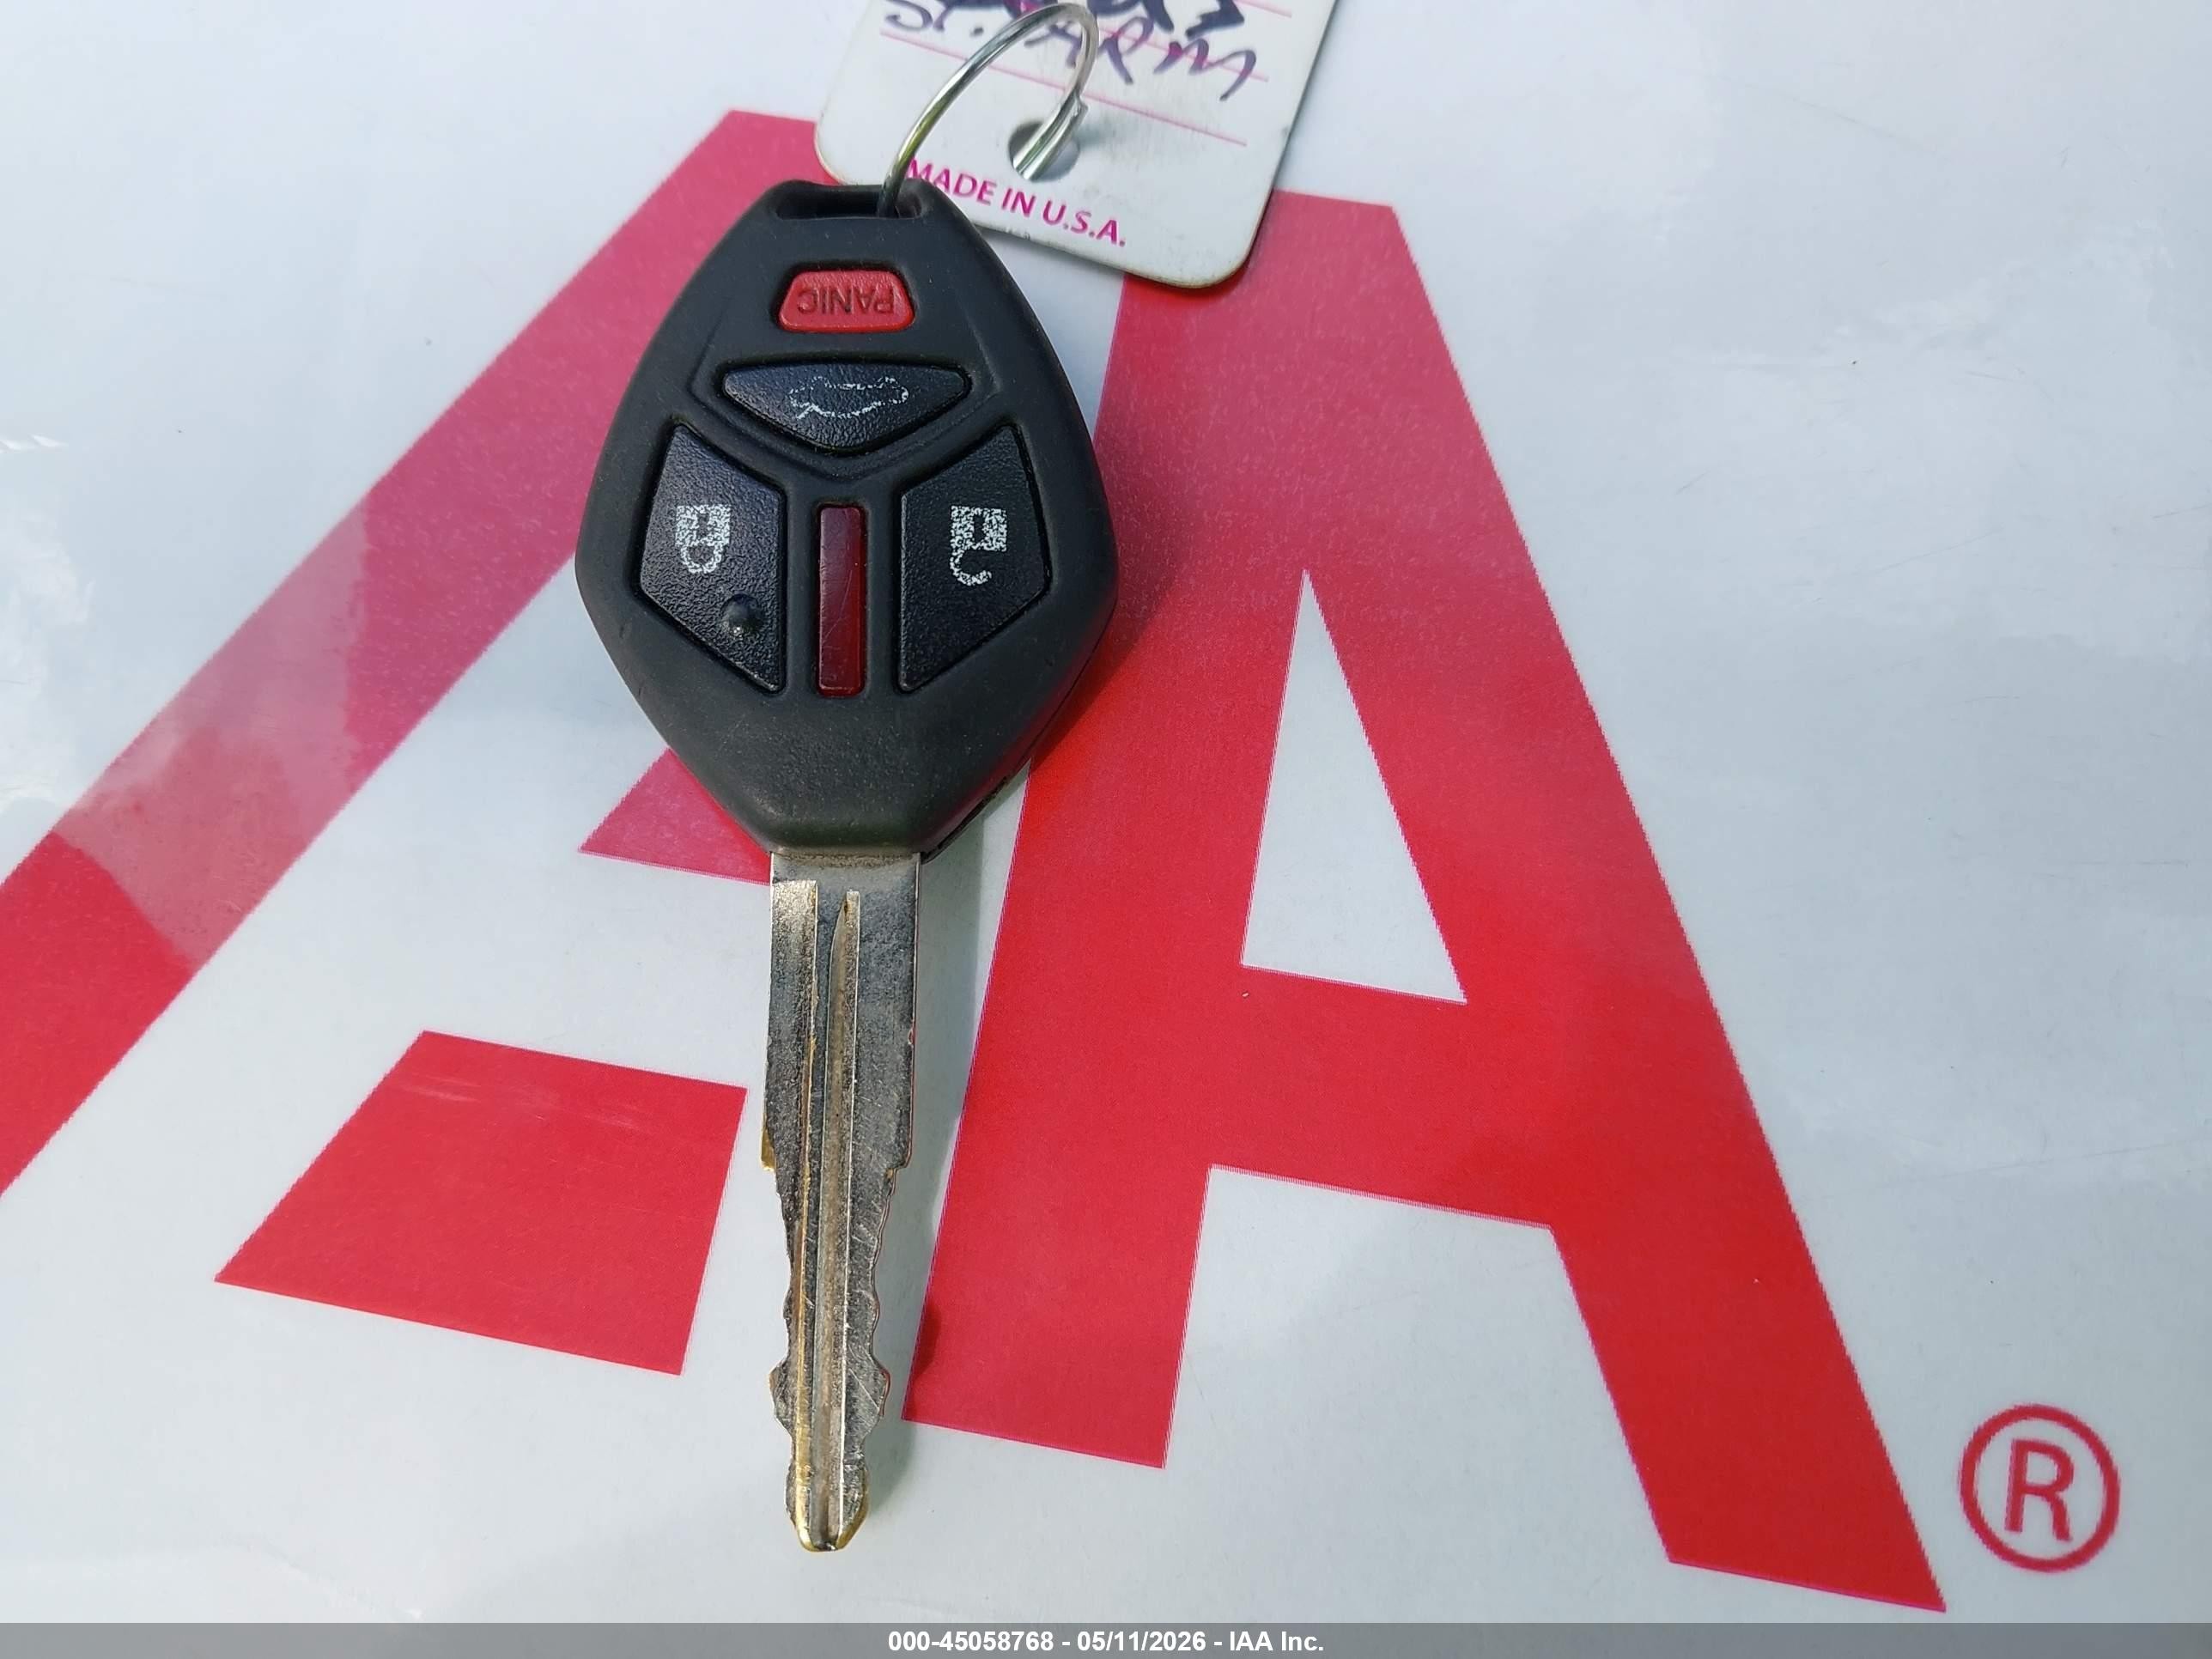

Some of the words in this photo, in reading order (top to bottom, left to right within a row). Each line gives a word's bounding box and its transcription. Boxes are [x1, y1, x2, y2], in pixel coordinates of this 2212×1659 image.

[903, 156, 997, 205] MADE
[1001, 187, 1036, 217] IN
[1042, 200, 1126, 247] U.S.A.
[797, 285, 895, 315] PANIC
